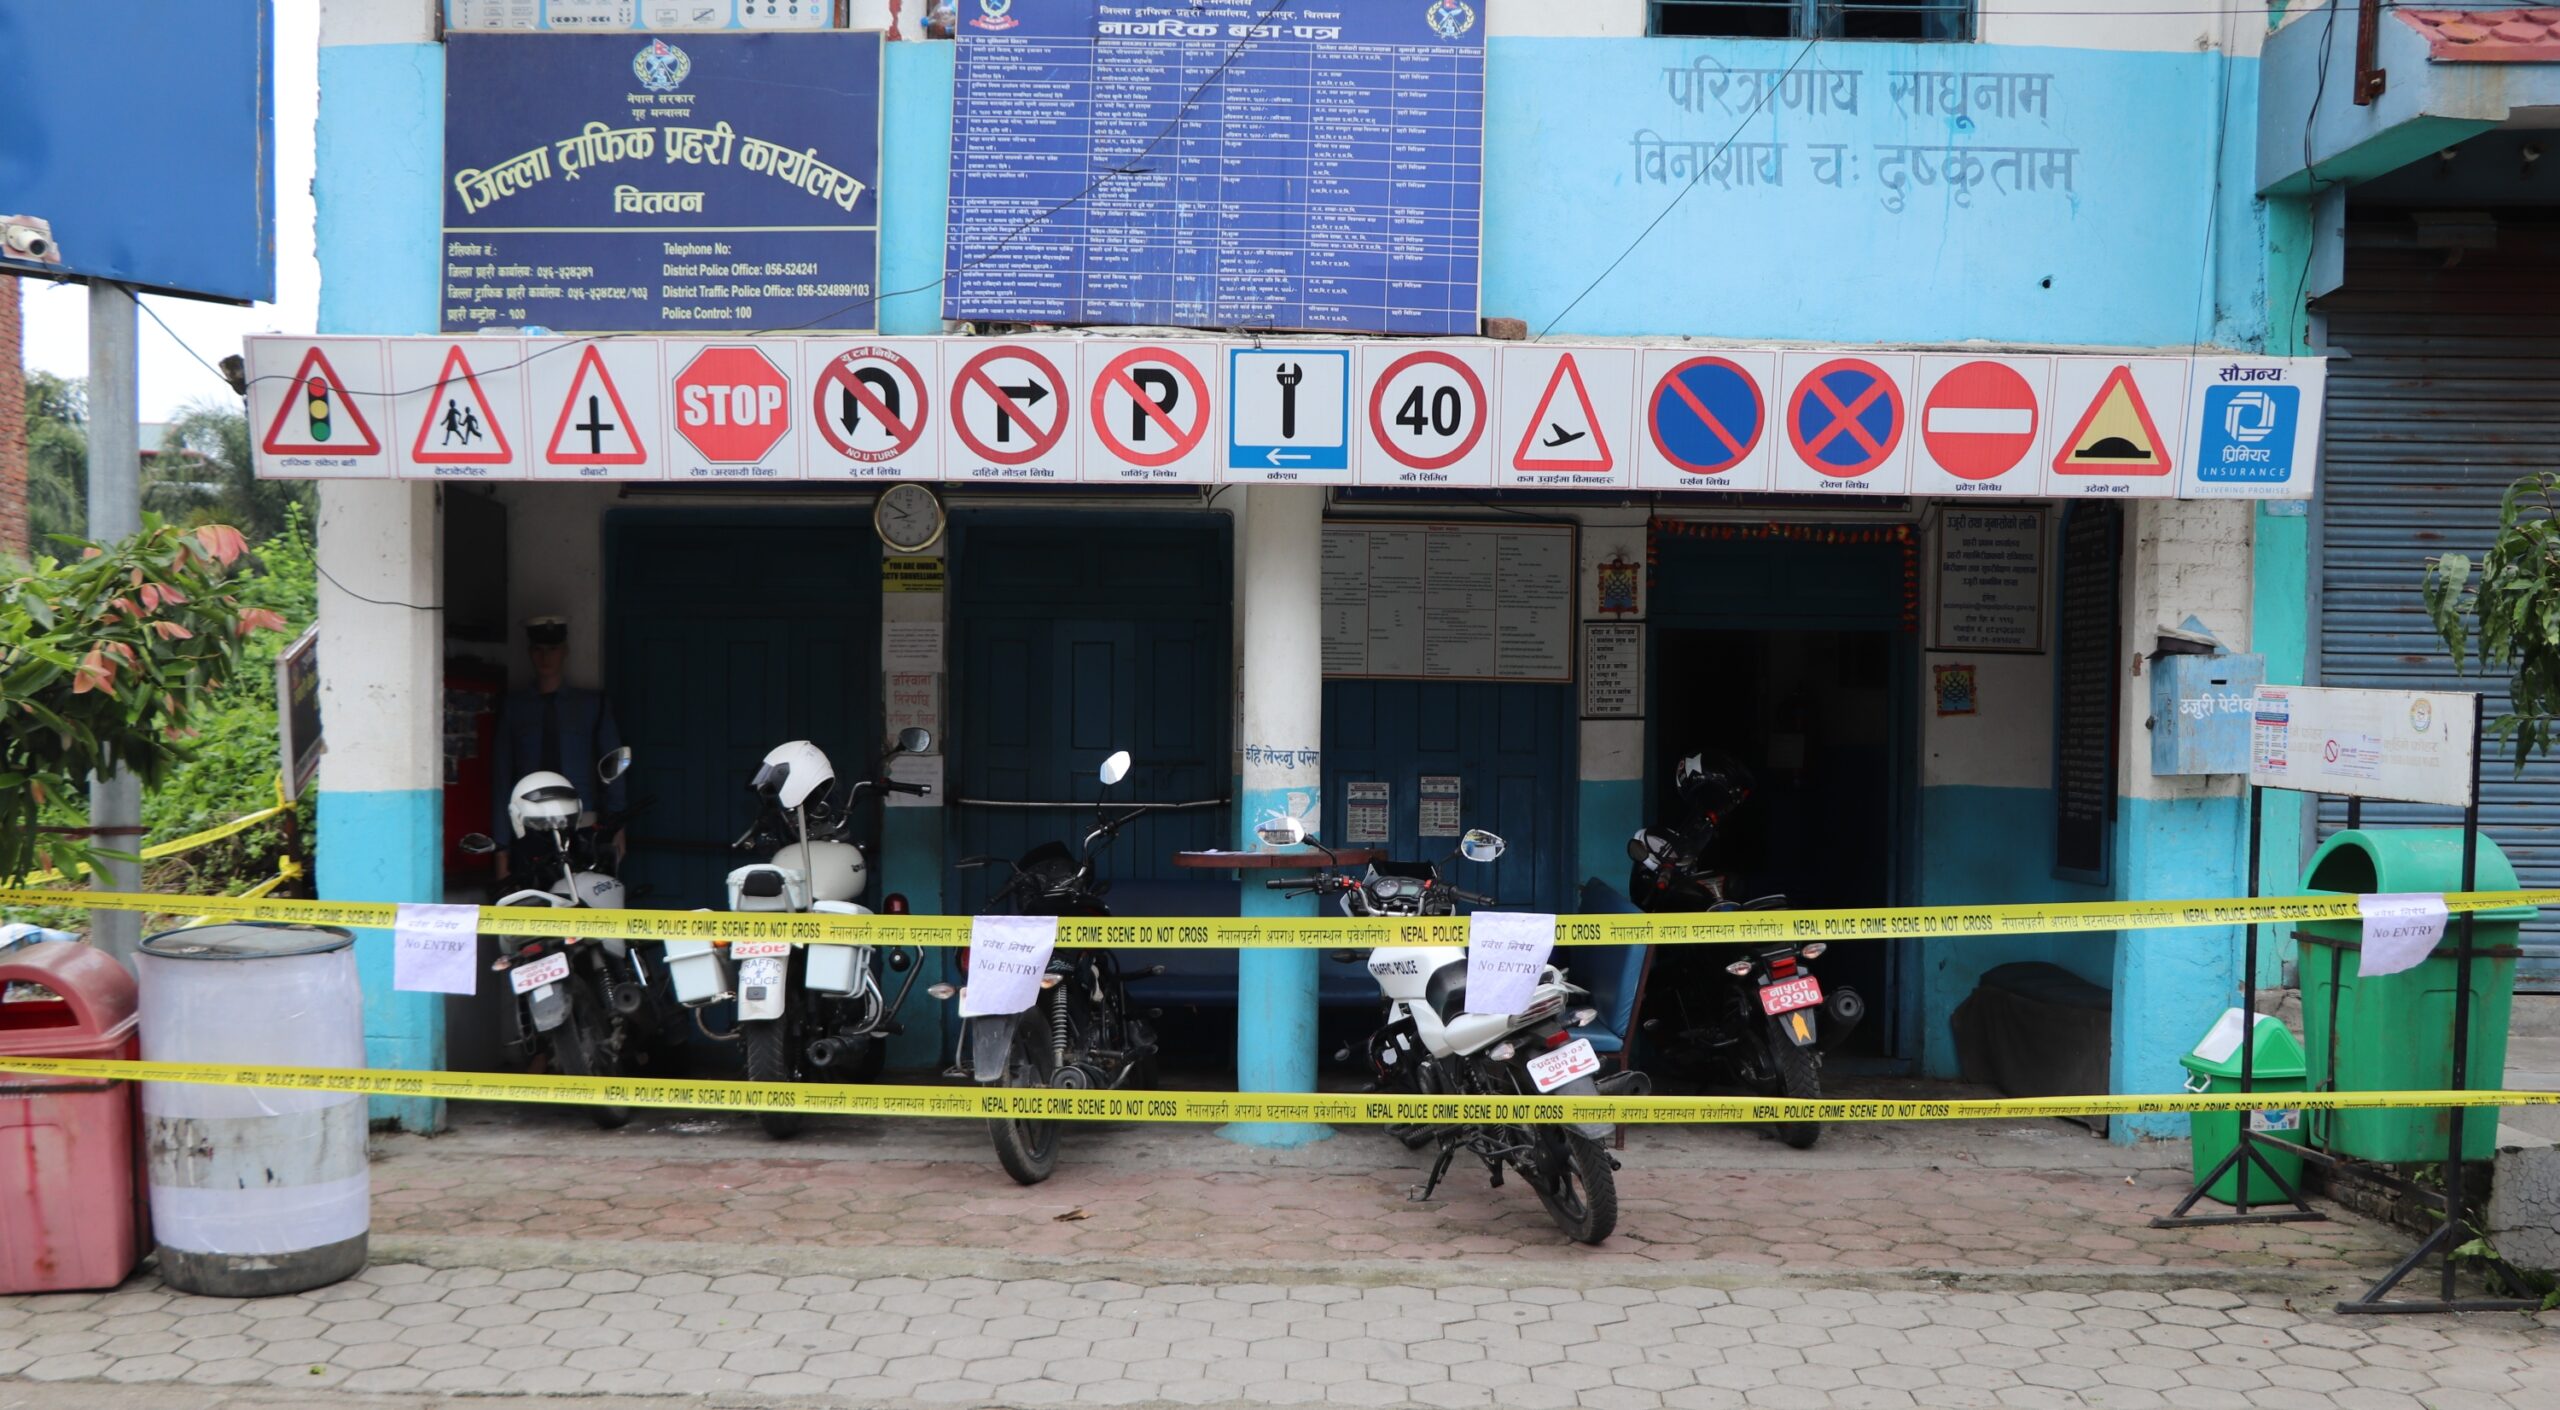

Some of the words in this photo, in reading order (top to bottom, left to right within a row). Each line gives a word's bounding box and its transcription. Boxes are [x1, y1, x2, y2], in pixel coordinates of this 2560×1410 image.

[1100, 6, 1130, 16] जिल्ला
[1303, 10, 1341, 20] चितवन
[1098, 19, 1219, 38] नागरिक
[1662, 55, 1863, 117] परित्राणाय
[627, 92, 653, 105] नेपाल
[659, 93, 695, 104] सरकार
[631, 108, 645, 121] गृह
[650, 108, 690, 118] मन्त्रालय
[454, 145, 552, 215] जिल्ला
[556, 121, 656, 181] ट्राफिक
[664, 121, 735, 165] प्रहरी
[739, 136, 866, 212] कार्यालय
[1628, 129, 1788, 190] विनाशाय
[1873, 144, 2080, 214] दुष्कृताम्
[614, 185, 704, 213] चितवन
[448, 242, 481, 256] टेलिफोन
[664, 242, 712, 257] Telephone
[714, 243, 731, 255] No:
[448, 263, 473, 278] जिल्ला
[476, 263, 495, 279] प्रहरी
[663, 264, 697, 276] District
[700, 264, 728, 276] Police
[731, 264, 762, 276] Office:
[765, 263, 818, 275] 056-524241
[448, 284, 473, 299] जिल्ला
[475, 284, 503, 302] ट्राफिक
[506, 284, 525, 300] प्रहरी
[663, 286, 697, 298] District
[700, 285, 729, 297] Traffic
[731, 285, 760, 297] Police
[763, 285, 794, 297] Office:
[797, 284, 869, 297] 056-524899/103
[447, 306, 466, 321] प्रहरी
[509, 309, 526, 320] १००
[662, 307, 691, 319] Police
[694, 307, 732, 319] Control:
[735, 306, 752, 318] 100
[683, 384, 782, 426] STOP
[1132, 368, 1178, 441] P
[1395, 385, 1461, 436] 40
[847, 448, 861, 458] NO
[872, 448, 899, 461] TURN
[2222, 445, 2270, 463] प्रिमियर
[690, 467, 708, 477] रोक
[849, 468, 857, 477] यू
[860, 467, 874, 476] टर्न
[877, 466, 901, 476] निषेध
[972, 466, 998, 476] दाहिने
[1030, 467, 1054, 477] निषेध
[1153, 469, 1177, 477] निषेध
[1267, 472, 1297, 480] वर्कशप
[1399, 472, 1416, 481] गति
[1420, 472, 1447, 481] सिमित
[2204, 467, 2286, 476] INSURANCE
[1516, 475, 1534, 483] कम
[1706, 477, 1730, 486] निषेध
[1820, 480, 1842, 489] रोक्न
[1845, 480, 1869, 489] निषेध
[1955, 483, 1975, 492] प्रवेश
[1978, 483, 2002, 491] निषेध
[2194, 486, 2246, 494] DELIVERING
[2180, 693, 2215, 719] उजुरी
[2183, 909, 2210, 923] NEPAL
[2215, 907, 2245, 920] POLICE
[2249, 906, 2276, 919] CRIME
[2281, 905, 2309, 919] SCENE
[2313, 904, 2327, 917] DO
[2330, 903, 2347, 916] NOT
[627, 919, 652, 934] NEPAL
[658, 919, 687, 935] POLICE
[692, 920, 717, 936] CRIME
[722, 921, 749, 937] SCENE
[754, 921, 766, 937] DO
[771, 922, 788, 938] NOT
[792, 922, 821, 938] CROSS
[1793, 920, 1821, 935] NEPAL
[1825, 919, 1856, 935] POLICE
[1860, 918, 1887, 934] CRIME
[1892, 917, 1920, 933] SCENE
[1924, 916, 1937, 932] DO
[1941, 916, 1958, 931] NOT
[1963, 915, 1992, 930] CROSS
[2373, 928, 2389, 938] No
[2393, 925, 2435, 938] ENTRY
[1266, 929, 1294, 944] अपराध
[1299, 930, 1342, 944] घटनास्थल
[405, 939, 421, 949] No
[424, 939, 466, 951] ENTRY
[744, 959, 782, 973] RAFFIC
[979, 960, 995, 971] No
[999, 961, 1040, 976] ENTRY
[1370, 962, 1395, 975] TRAFFIC
[1393, 960, 1418, 975] POLICE
[1478, 960, 1495, 971] No
[1498, 961, 1540, 975] ENTRY
[1767, 990, 1819, 1011] ८२२७
[1366, 1103, 1393, 1119] NEPAL
[1397, 1103, 1428, 1119] POLICE
[1432, 1103, 1458, 1119] CRIME
[1463, 1104, 1491, 1119] SCENE
[1496, 1104, 1507, 1119] DO
[1512, 1104, 1529, 1119] NOT
[1534, 1104, 1563, 1119] CROSS
